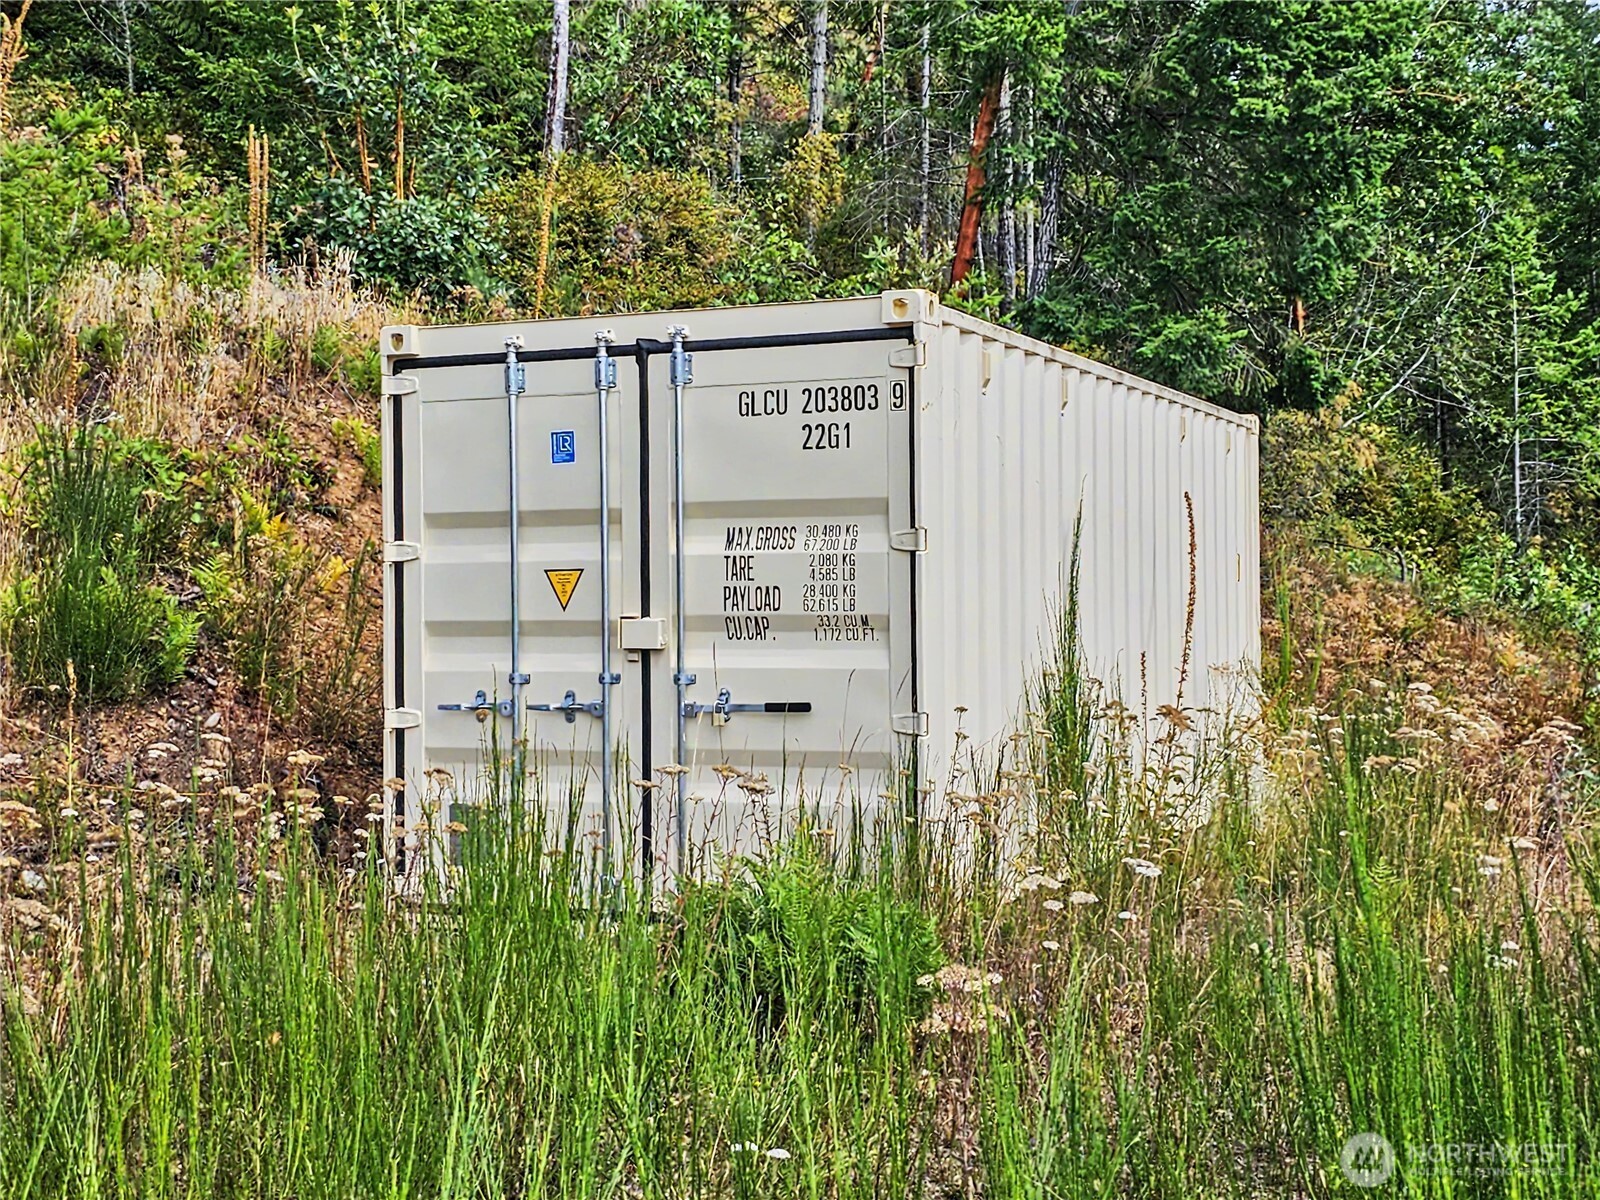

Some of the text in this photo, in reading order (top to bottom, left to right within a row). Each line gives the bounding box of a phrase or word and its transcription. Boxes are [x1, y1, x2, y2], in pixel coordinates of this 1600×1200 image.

[738, 382, 905, 417] GLCU 203803 9
[801, 422, 851, 450] 22G1
[845, 524, 858, 538] KG
[843, 538, 857, 551] LB
[723, 555, 755, 581] TARE
[842, 553, 856, 567] KG
[842, 567, 856, 581] LB
[723, 585, 781, 612] PAYLOAD
[842, 584, 856, 598] KG
[842, 598, 856, 612] LB
